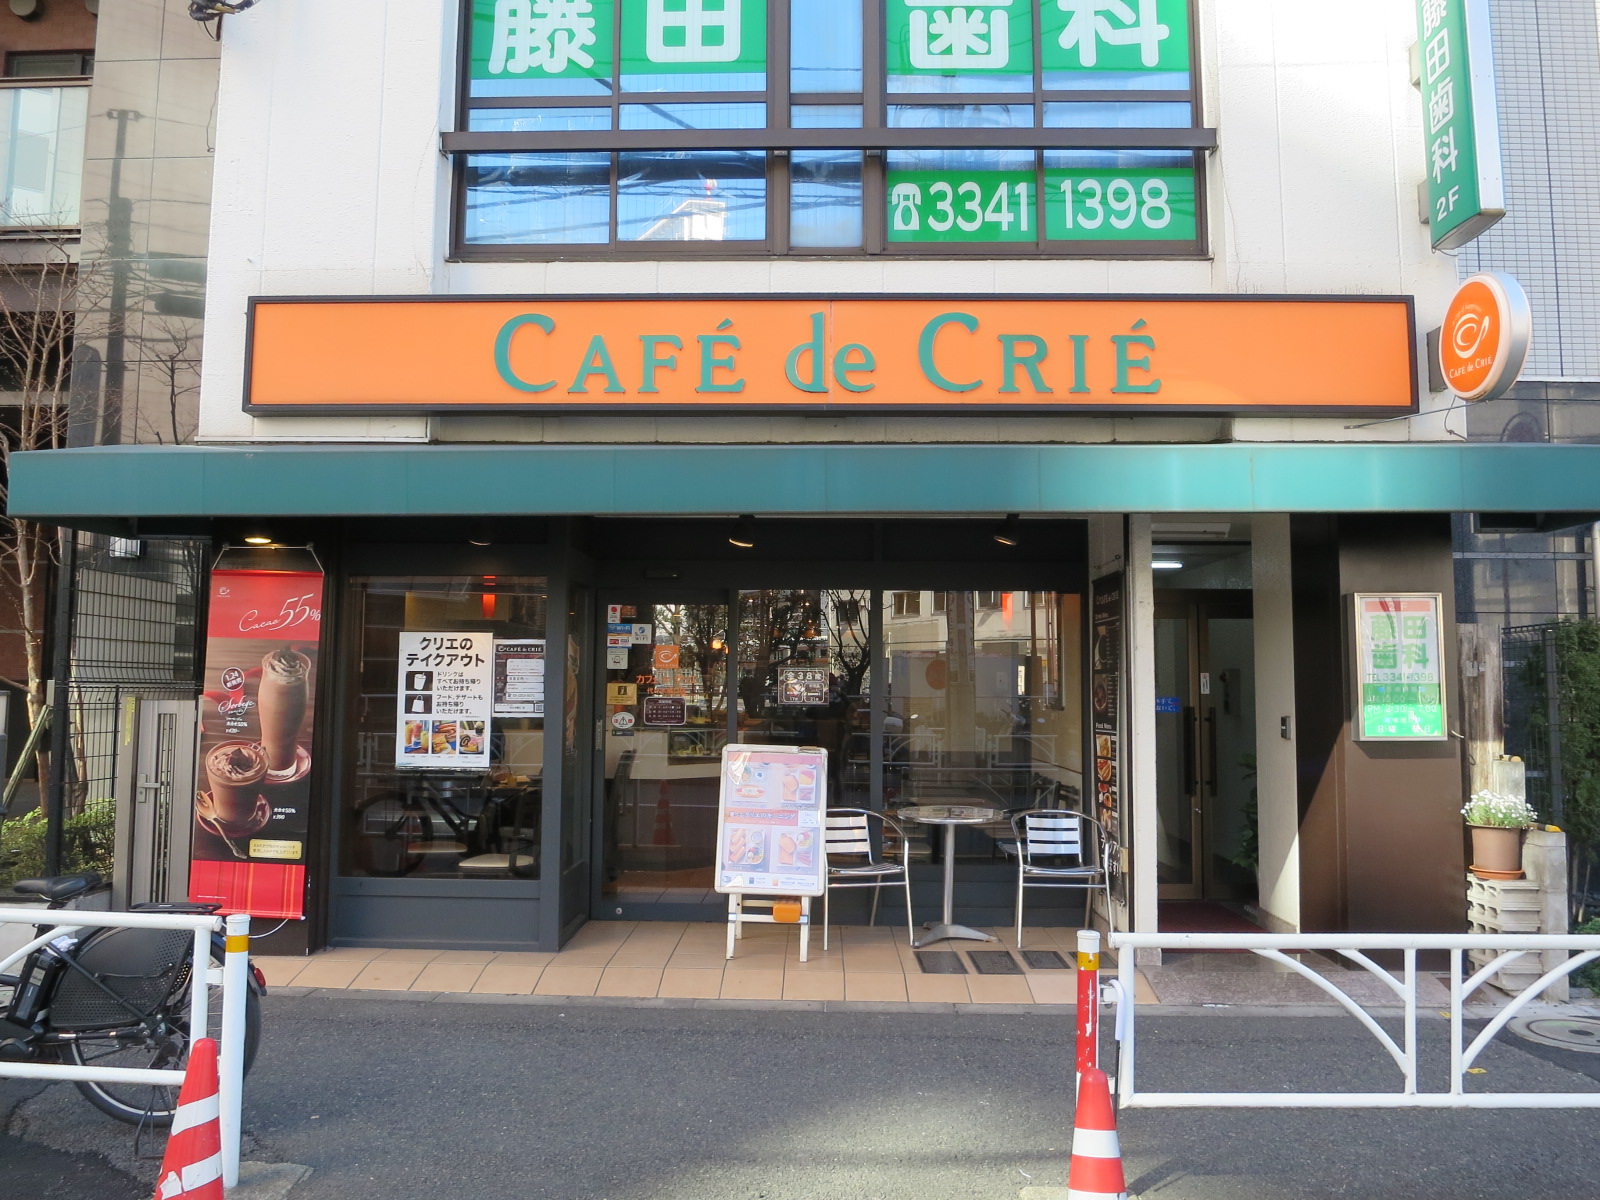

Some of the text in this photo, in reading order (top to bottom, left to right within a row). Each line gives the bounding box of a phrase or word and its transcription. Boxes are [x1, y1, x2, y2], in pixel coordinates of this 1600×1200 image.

[927, 178, 1172, 232] 3341 1398
[1436, 184, 1460, 223] 2F
[494, 312, 1161, 393] CAFÉ de CRIÉ
[239, 609, 281, 632] Cacao
[419, 636, 473, 651] クリエの
[406, 653, 485, 668] テイクアウト
